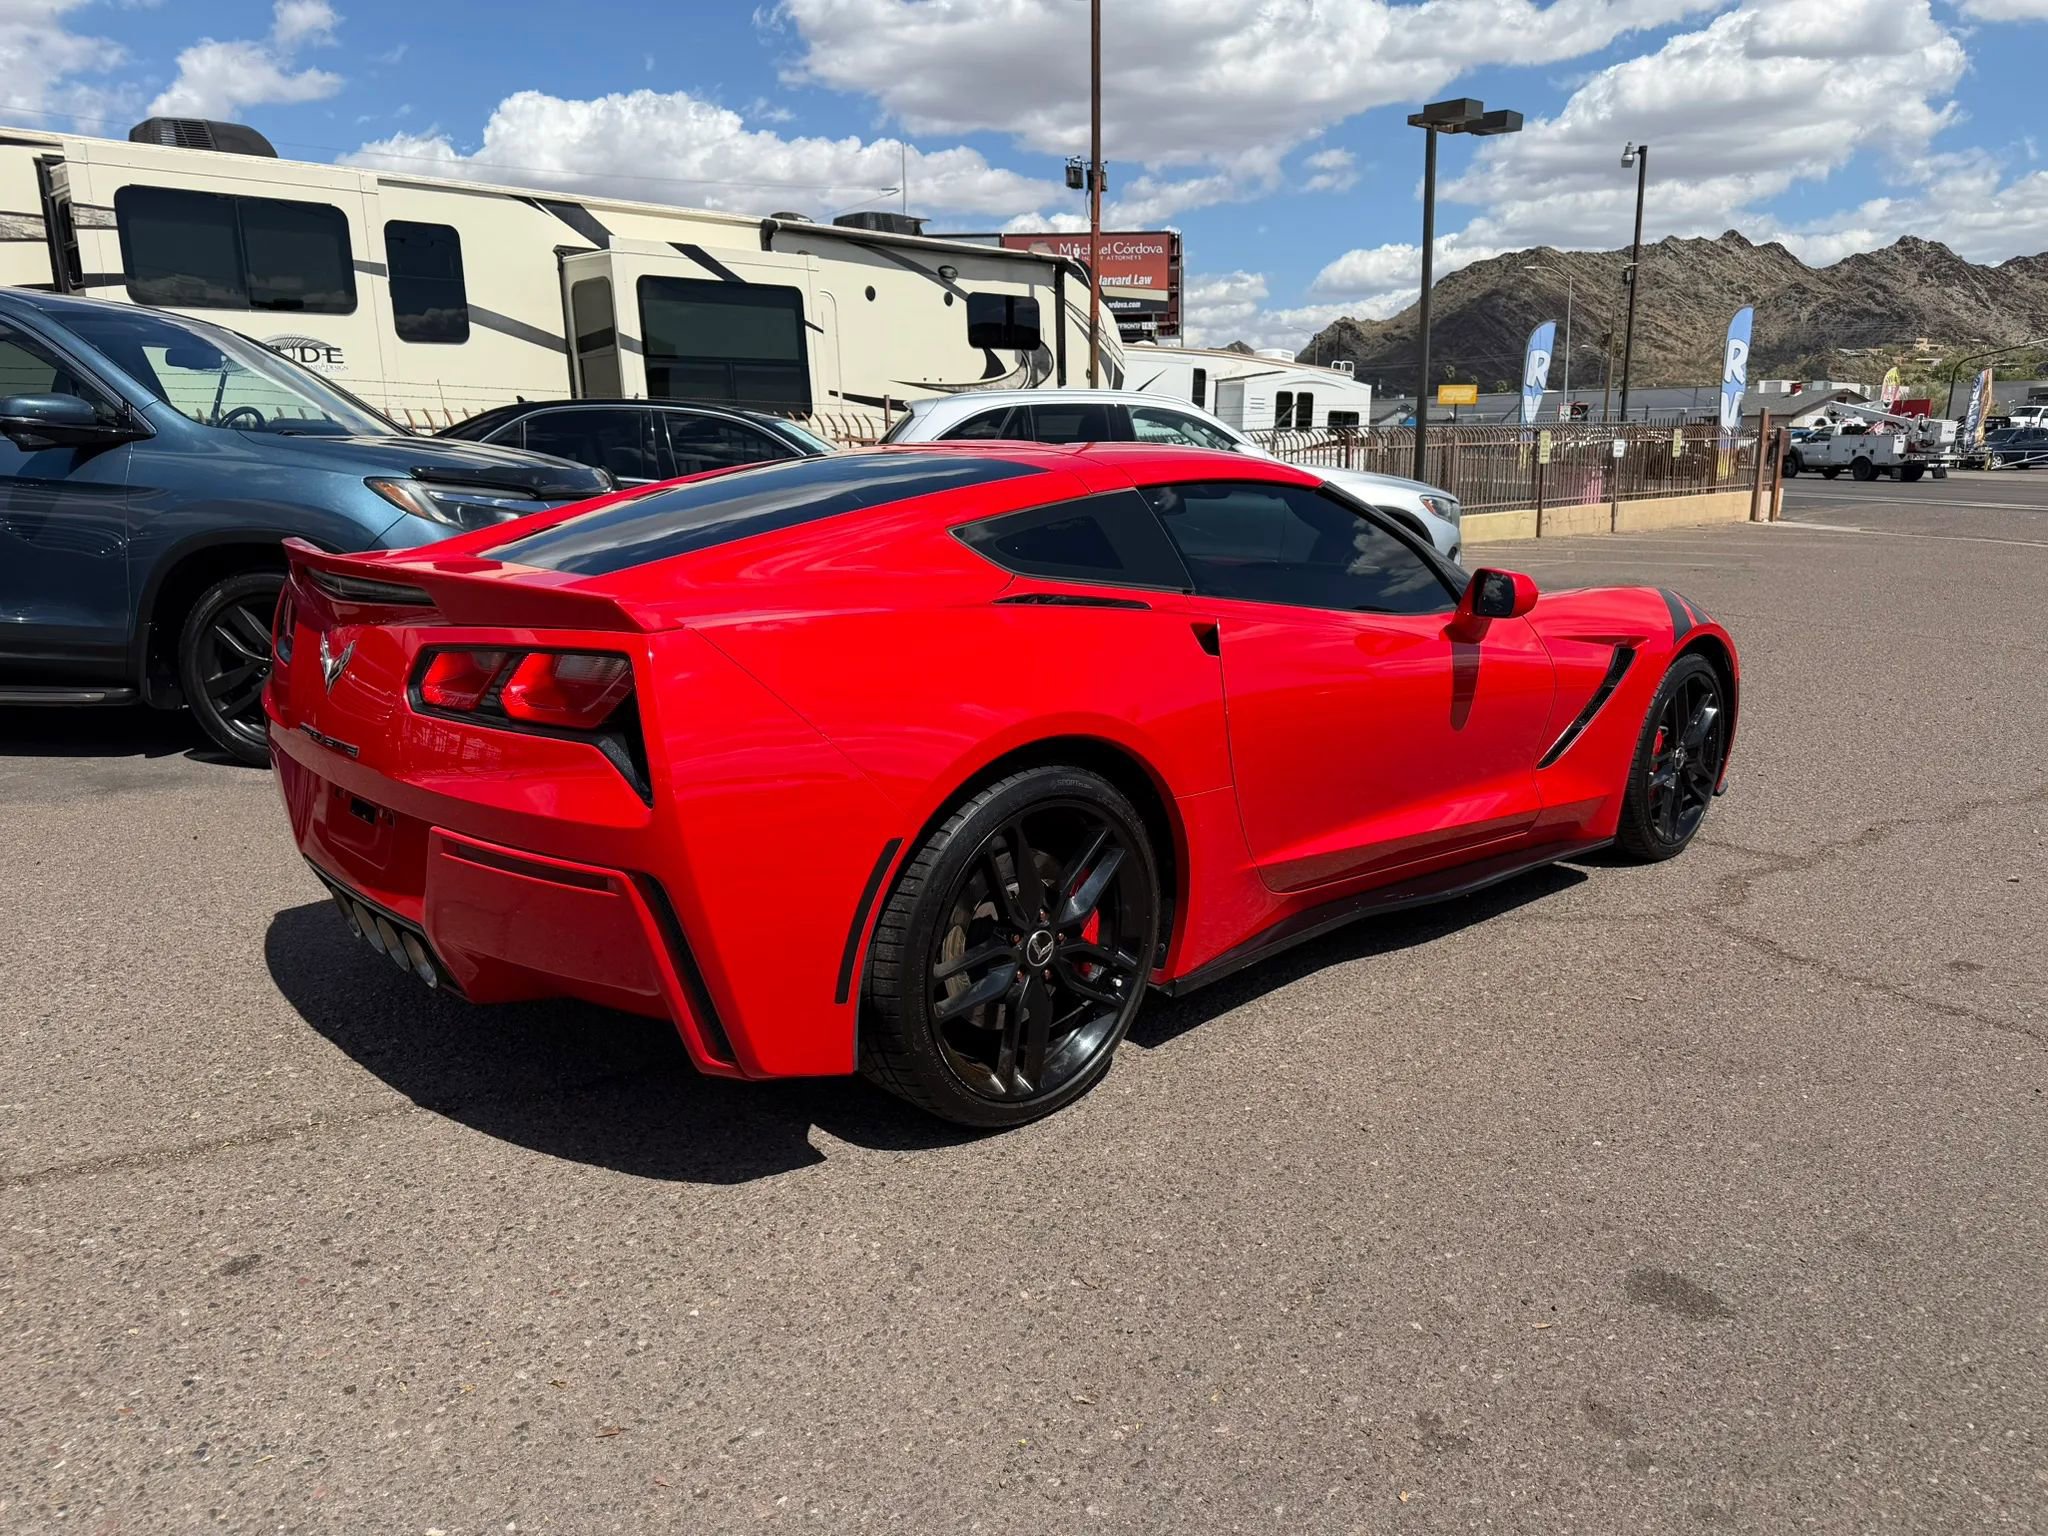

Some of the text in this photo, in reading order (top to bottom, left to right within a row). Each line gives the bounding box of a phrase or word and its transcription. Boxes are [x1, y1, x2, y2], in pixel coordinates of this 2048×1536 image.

[1059, 242, 1163, 256] Micel Córdova
[1133, 274, 1153, 285] Law
